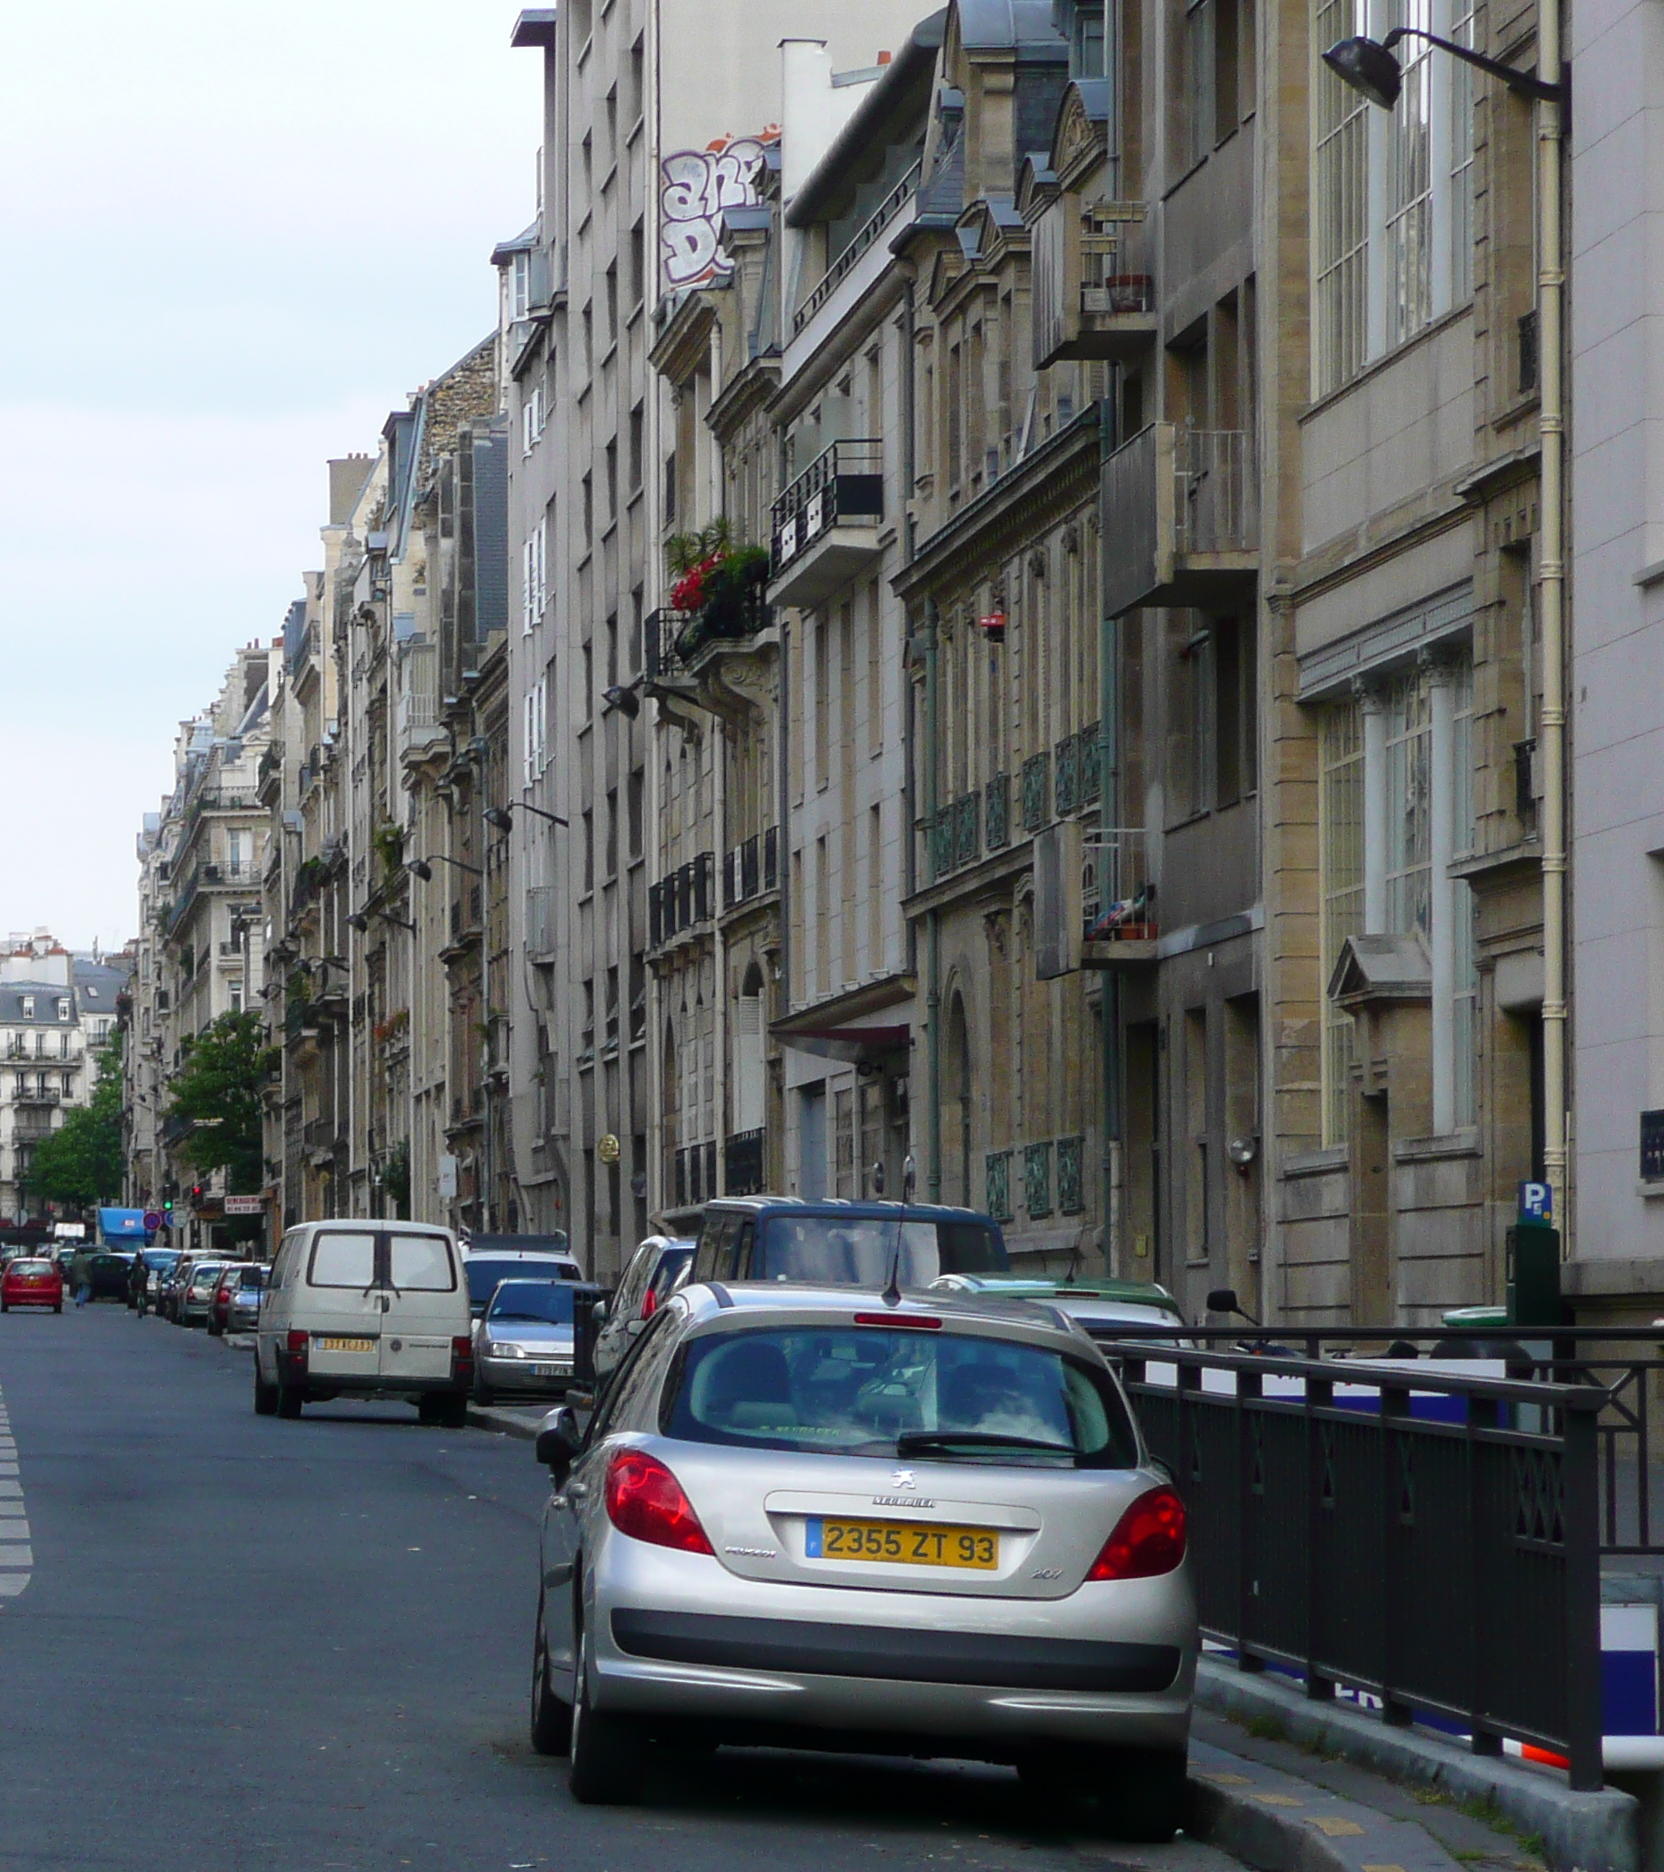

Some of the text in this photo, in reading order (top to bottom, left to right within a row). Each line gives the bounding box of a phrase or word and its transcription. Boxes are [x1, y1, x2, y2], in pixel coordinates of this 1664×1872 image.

[1525, 1183, 1546, 1209] P
[826, 1527, 994, 1564] 2355 ZT 93
